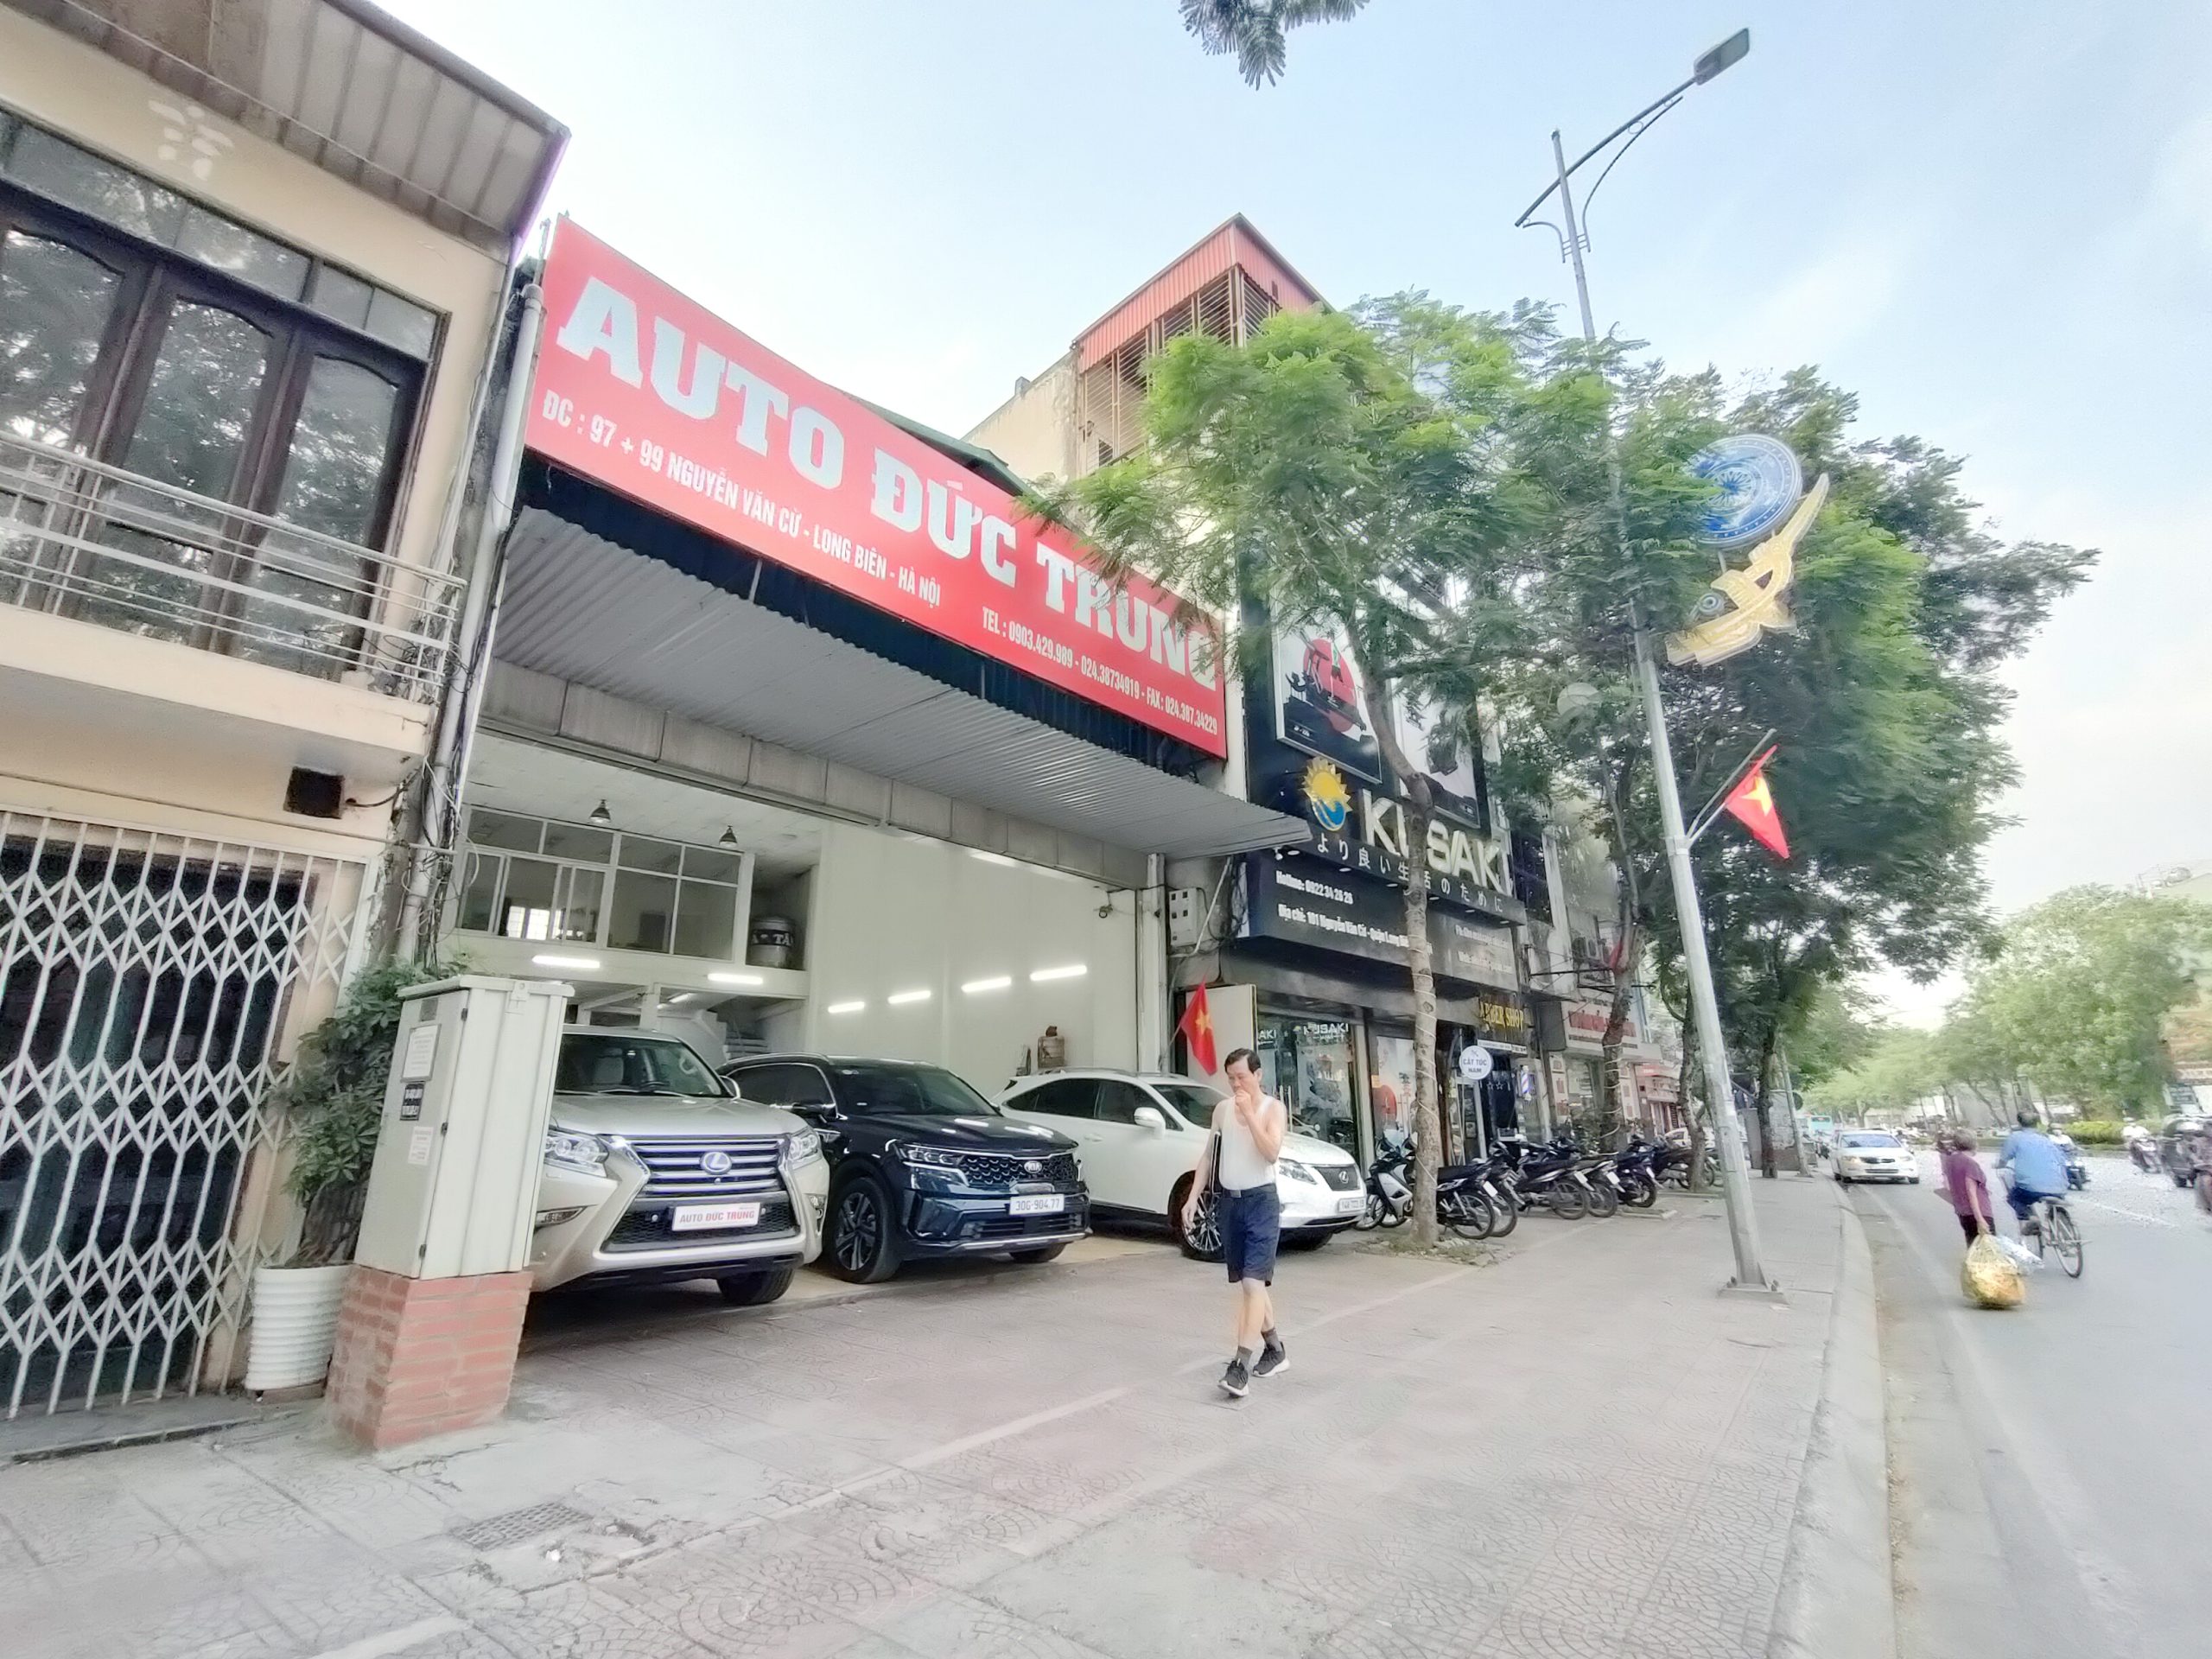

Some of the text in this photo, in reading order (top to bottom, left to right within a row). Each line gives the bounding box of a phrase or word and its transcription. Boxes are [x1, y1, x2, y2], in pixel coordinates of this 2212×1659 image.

[556, 276, 1217, 691] AUTO ĐỨC TRUNG
[589, 414, 617, 448] 97
[639, 439, 664, 474] 99
[667, 450, 739, 510] NGUYỄN
[742, 486, 775, 528] VĂN
[779, 507, 802, 538] CỪ
[812, 524, 852, 563] LONG
[854, 544, 887, 581] BIÊN
[898, 566, 916, 595] HÀ
[918, 575, 941, 608] NỘI
[1008, 620, 1073, 669] 0903.429.989
[1081, 655, 1140, 700] 024.38734919
[679, 1213, 703, 1224] AUTO
[727, 1211, 755, 1220] TRUNG
